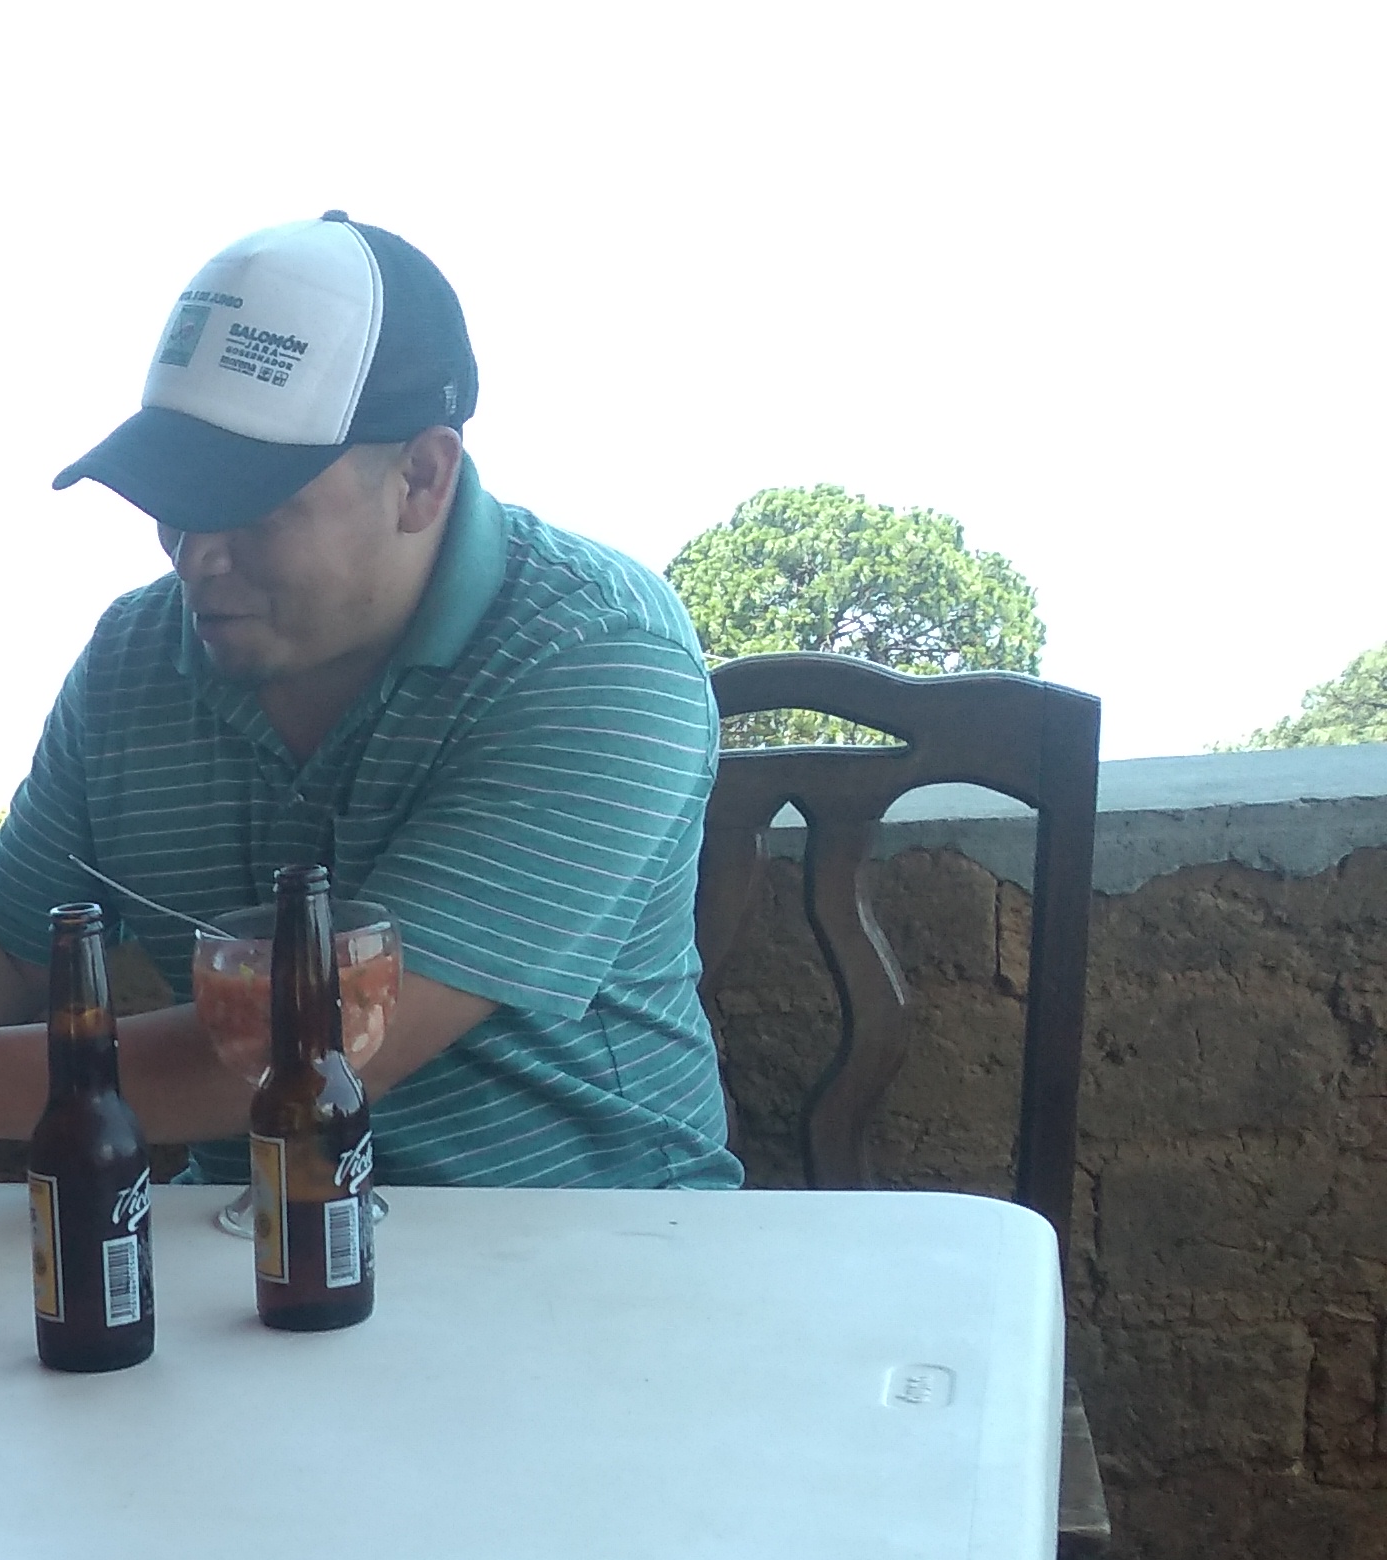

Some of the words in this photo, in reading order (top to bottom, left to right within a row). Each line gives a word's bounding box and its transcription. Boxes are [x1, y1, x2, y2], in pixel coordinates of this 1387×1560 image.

[229, 322, 309, 356] SALOMÓN
[244, 340, 279, 358] JARA
[225, 345, 294, 372] GOBERNADOR
